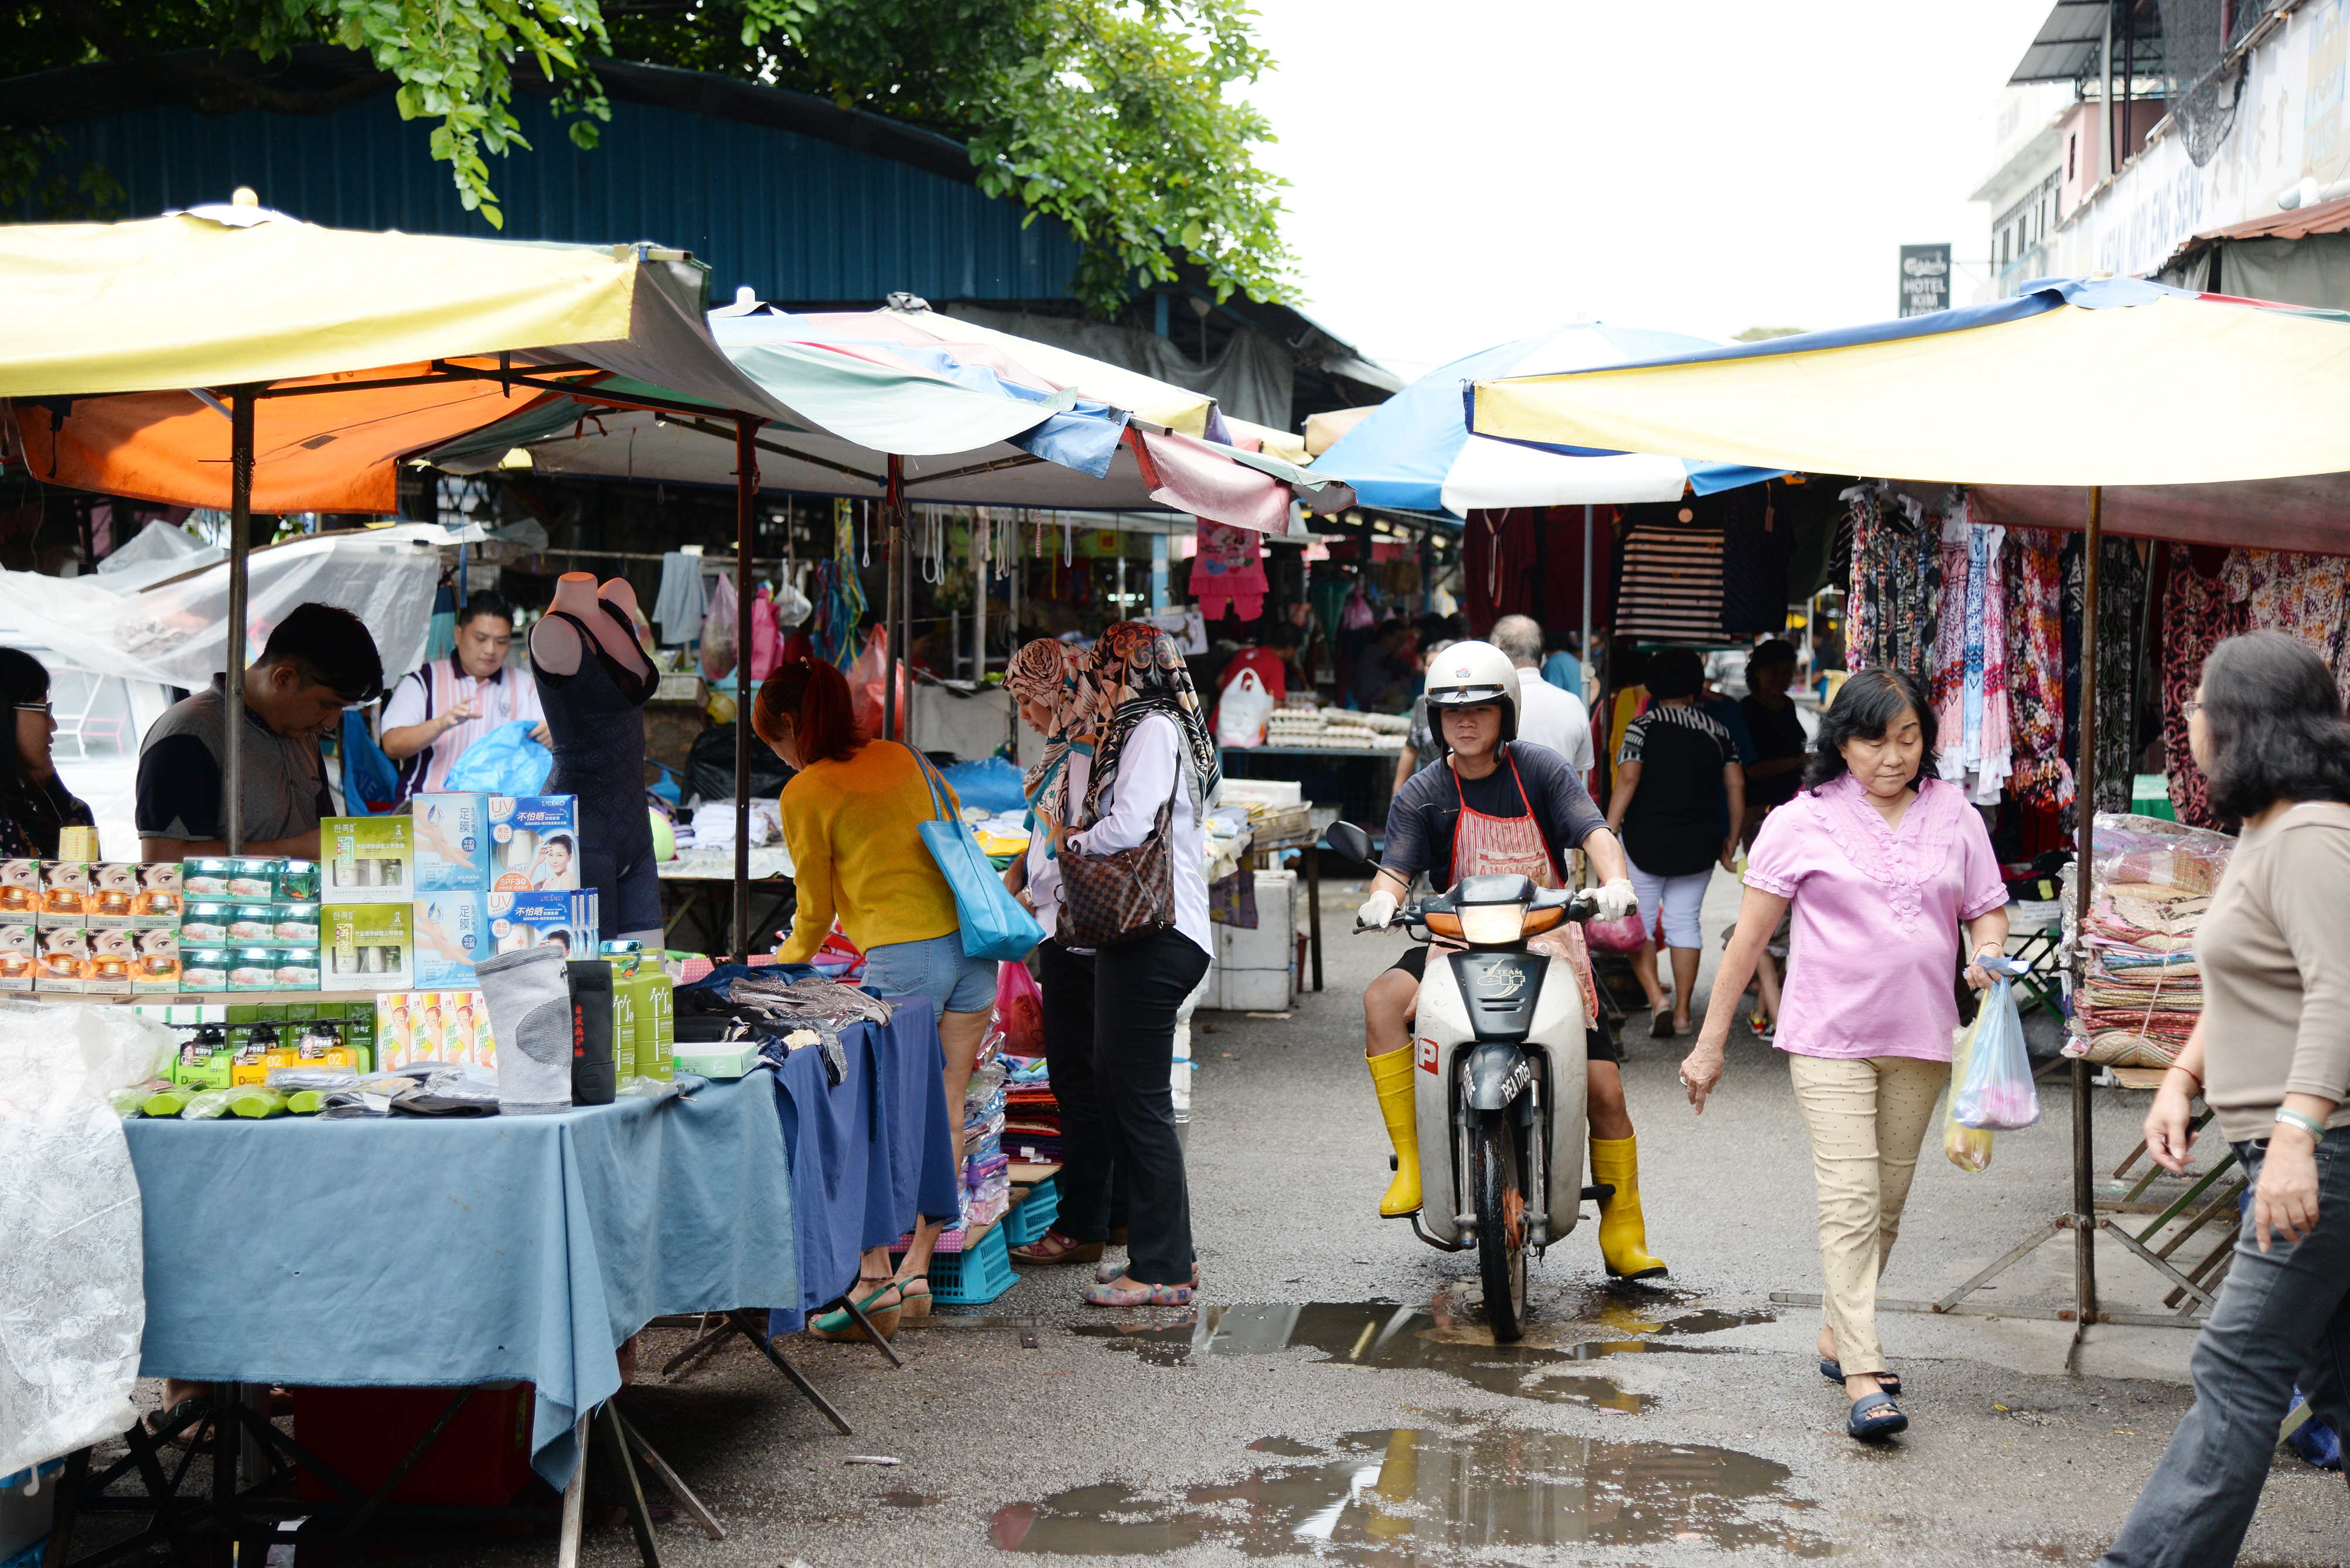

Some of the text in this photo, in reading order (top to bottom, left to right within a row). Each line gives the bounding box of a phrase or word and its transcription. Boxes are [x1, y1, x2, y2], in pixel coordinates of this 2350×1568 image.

[1903, 277, 1947, 294] HOTEL
[1911, 293, 1938, 308] KIM
[492, 800, 514, 813] UV
[459, 808, 470, 833] 足膜
[517, 812, 545, 822] 不怕晒
[333, 824, 349, 833] 한록
[490, 895, 512, 908] UV
[333, 911, 348, 920] 한록
[516, 907, 544, 917] 不怕晒
[459, 905, 470, 931] 足膜
[1477, 975, 1526, 986] elf
[300, 1048, 311, 1057] 02
[1418, 1037, 1437, 1067] P
[180, 1055, 192, 1064] 01
[211, 1057, 225, 1068] 01
[267, 1055, 282, 1067] 02
[328, 1054, 342, 1065] 02
[238, 1076, 258, 1085] Debut
[1501, 1060, 1530, 1104] PEA 1705
